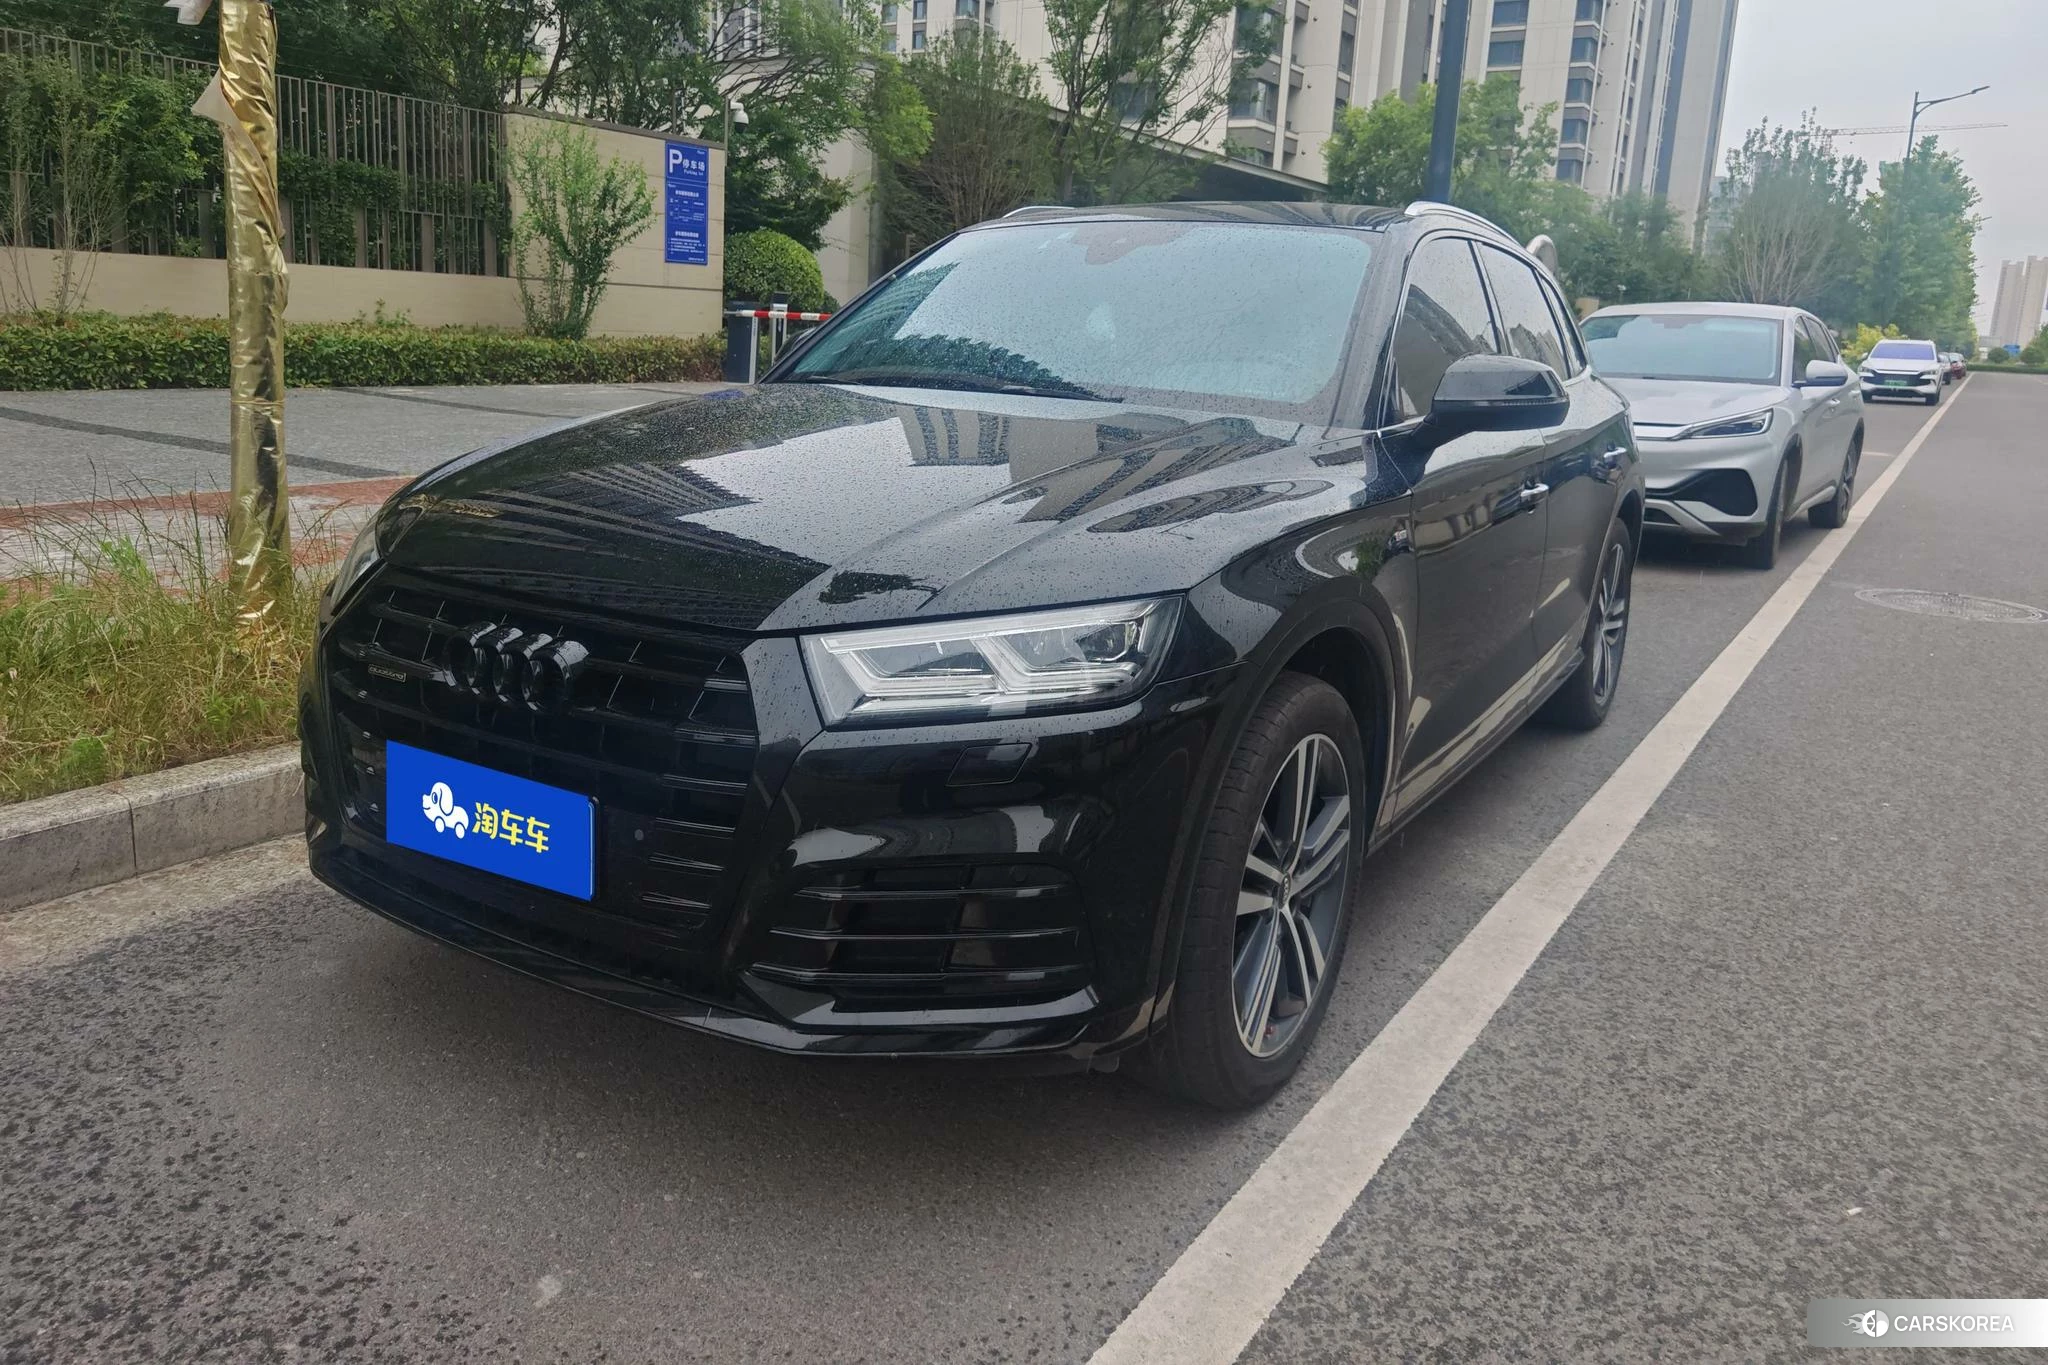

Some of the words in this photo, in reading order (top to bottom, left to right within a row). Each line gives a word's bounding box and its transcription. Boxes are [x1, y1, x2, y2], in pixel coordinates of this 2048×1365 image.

[669, 149, 682, 173] P
[683, 159, 705, 171] 停车场
[472, 801, 551, 854] 淘车车
